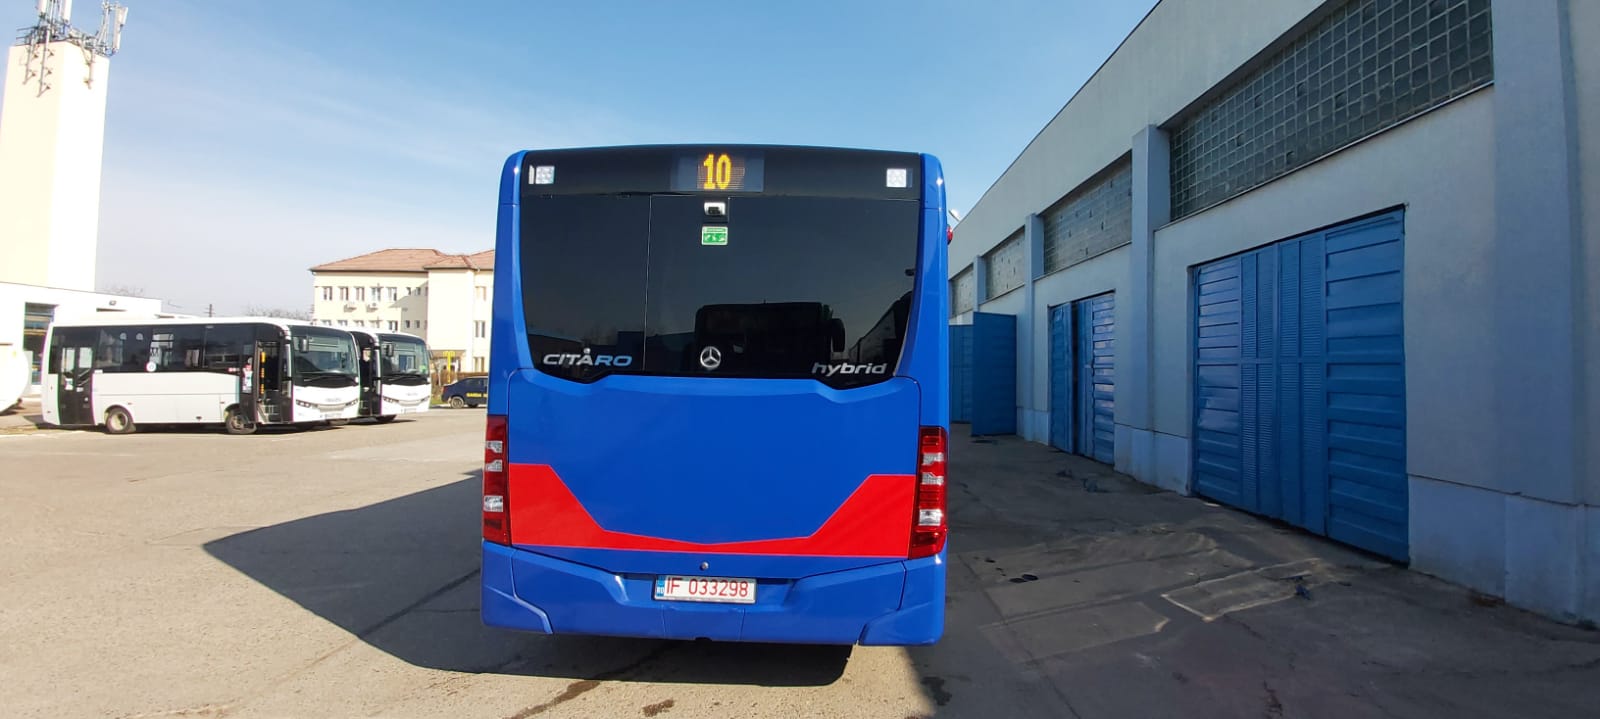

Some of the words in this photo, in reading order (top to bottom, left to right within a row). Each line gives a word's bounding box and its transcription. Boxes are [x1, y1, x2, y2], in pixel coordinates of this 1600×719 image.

[703, 154, 731, 190] 10
[543, 353, 633, 367] CITARO
[811, 362, 888, 377] hybrid
[666, 577, 683, 594] IF
[688, 578, 749, 597] 033298
